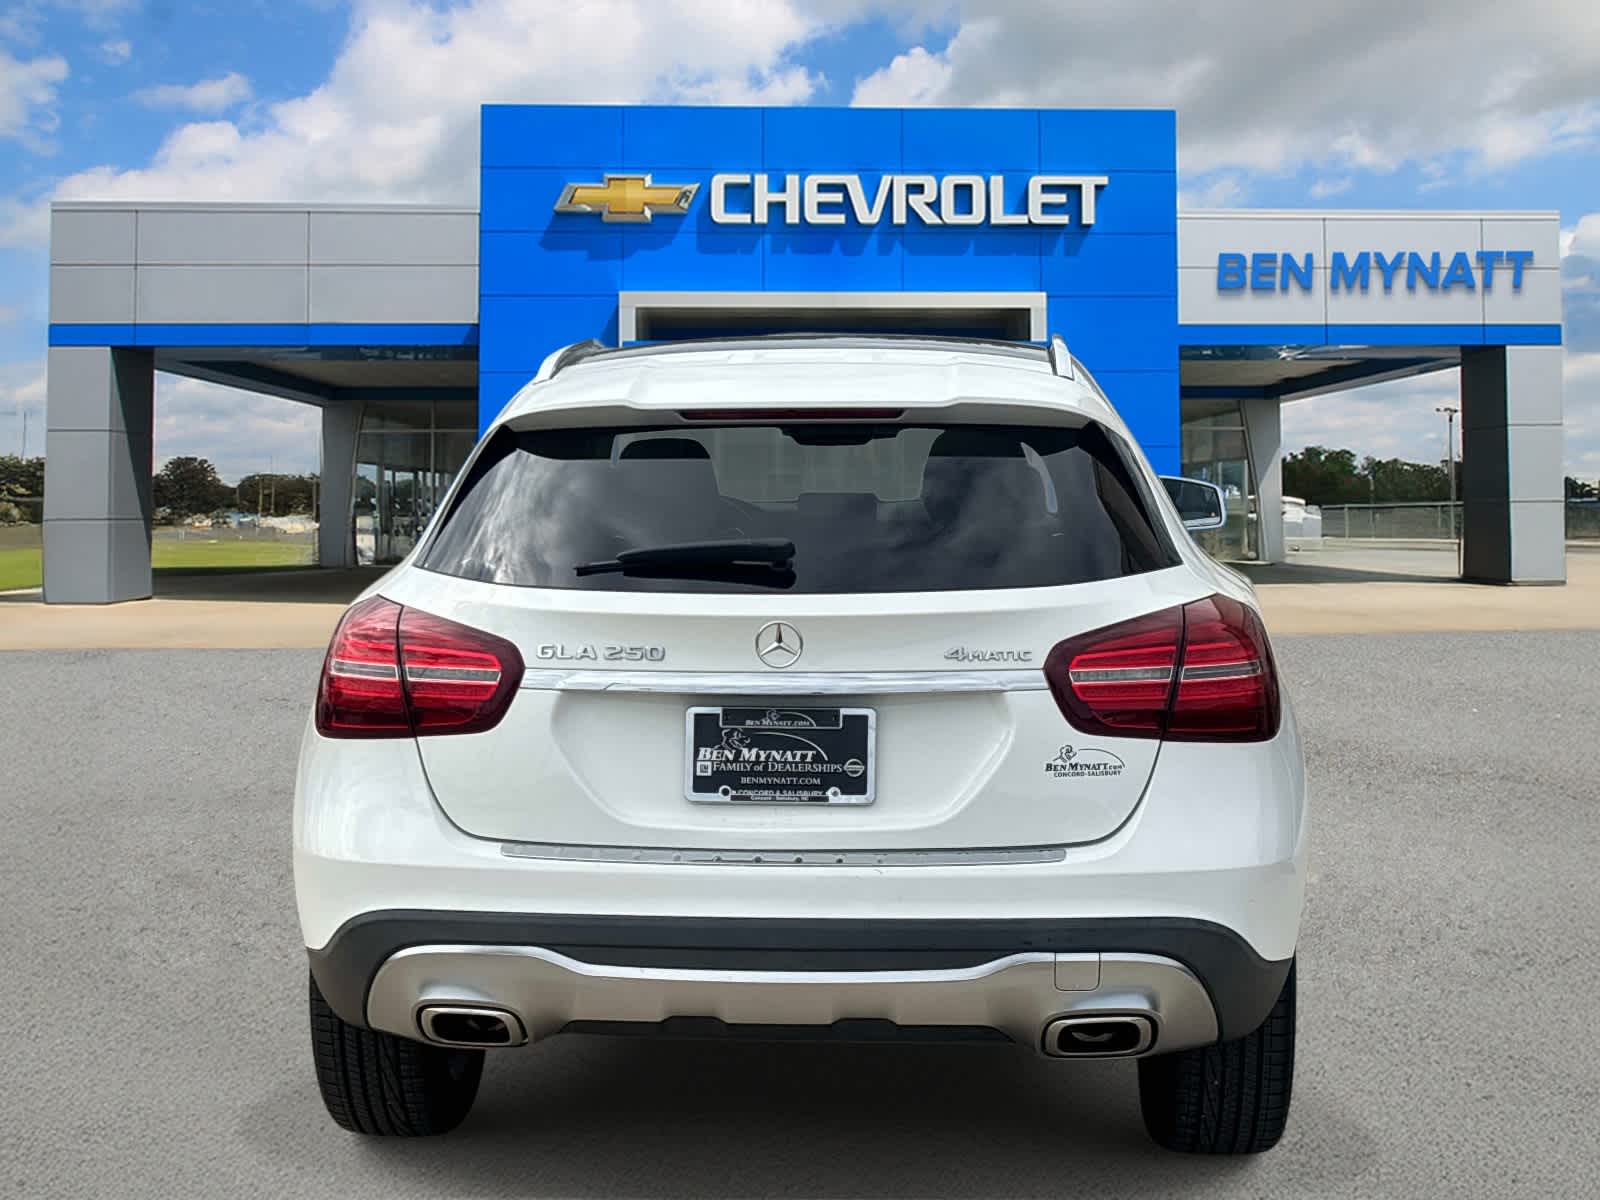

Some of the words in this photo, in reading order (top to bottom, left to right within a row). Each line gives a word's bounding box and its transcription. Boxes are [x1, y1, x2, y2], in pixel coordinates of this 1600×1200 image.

[710, 173, 1109, 226] CHEVROLET
[1217, 252, 1313, 291] BEN
[1330, 250, 1534, 291] MYNATT
[536, 643, 597, 661] GLA
[603, 645, 666, 661] 250
[739, 747, 816, 762] MYNATT
[712, 761, 752, 772] FAMILY
[767, 761, 843, 773] DEALERSHIPS
[740, 776, 821, 785] BENMYNATT.COM
